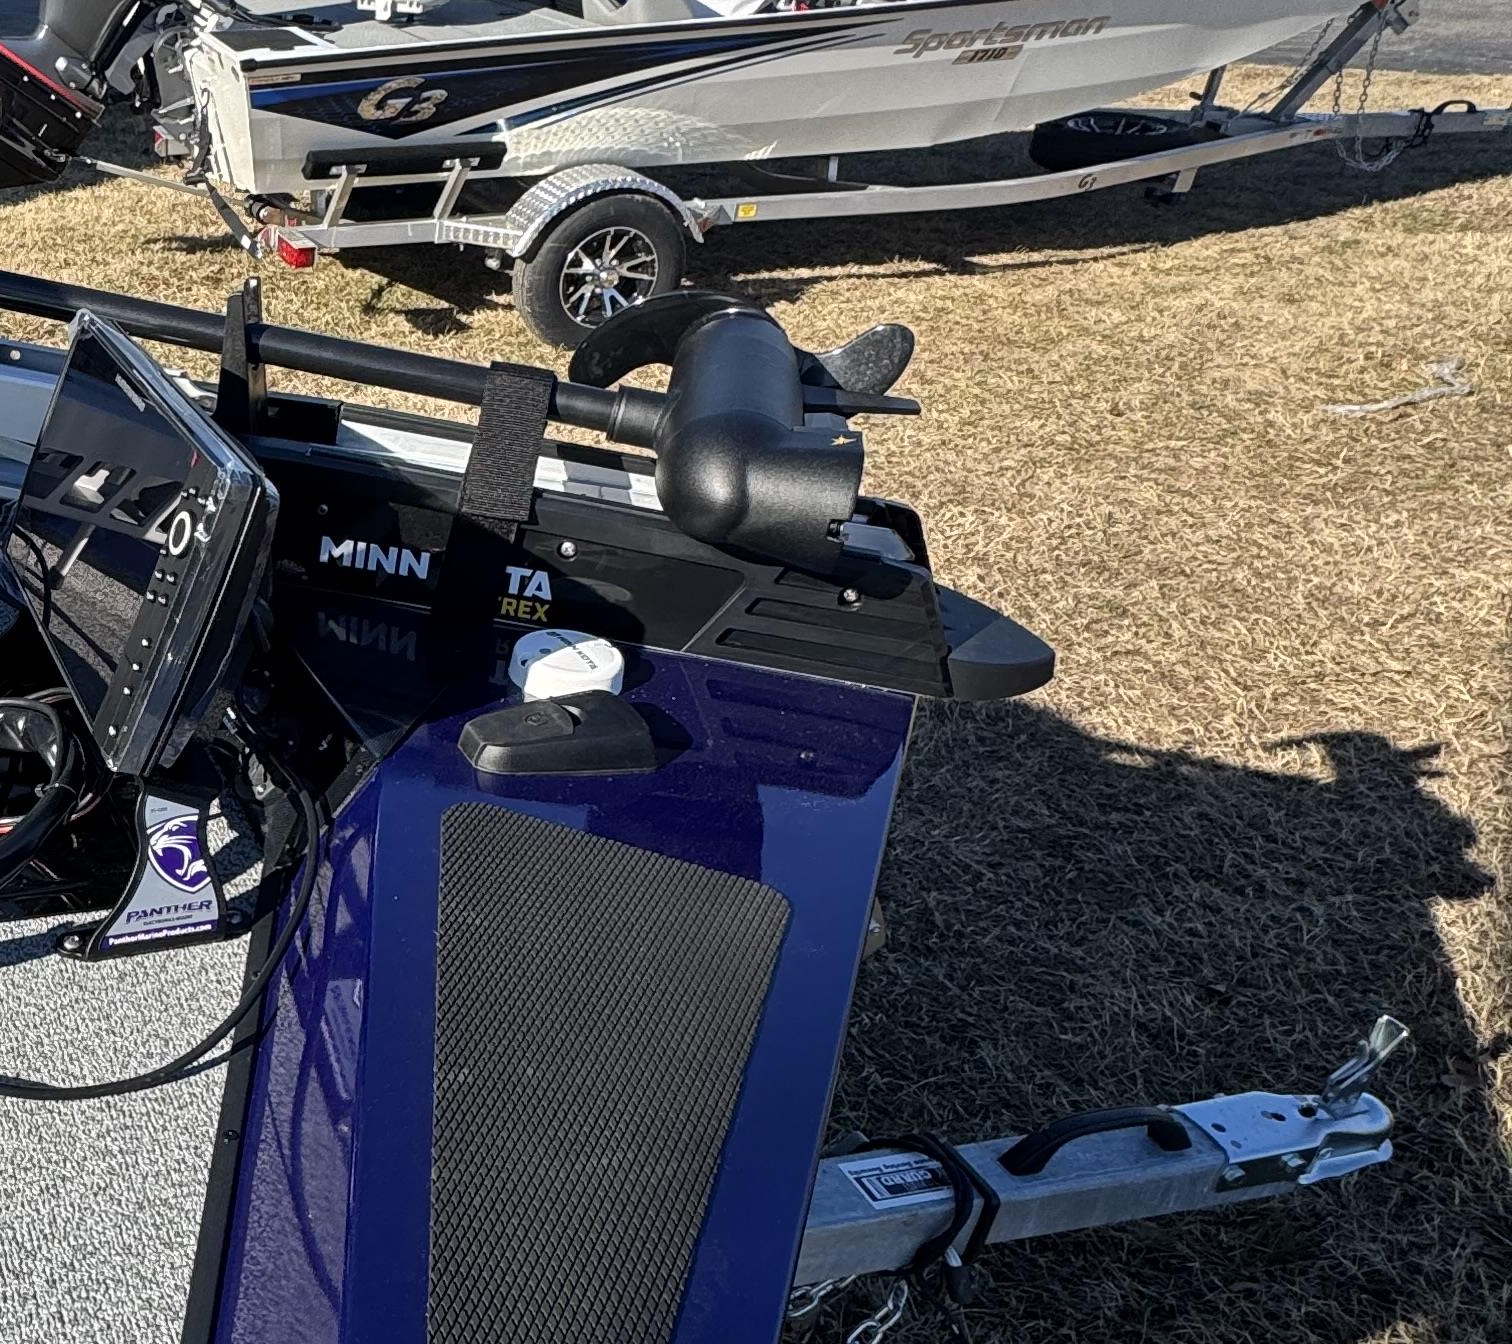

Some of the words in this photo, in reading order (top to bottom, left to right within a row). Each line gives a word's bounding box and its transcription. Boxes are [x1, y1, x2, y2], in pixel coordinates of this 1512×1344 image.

[892, 15, 1112, 59] Sportsman
[356, 75, 449, 123] G3
[319, 535, 431, 580] MINN
[505, 565, 552, 601] TA
[498, 596, 551, 623] REX
[576, 650, 599, 670] KOTA
[125, 899, 213, 925] PANTHER
[108, 923, 213, 946] PantherMarineProducts.com
[880, 1169, 933, 1186] GUARD
